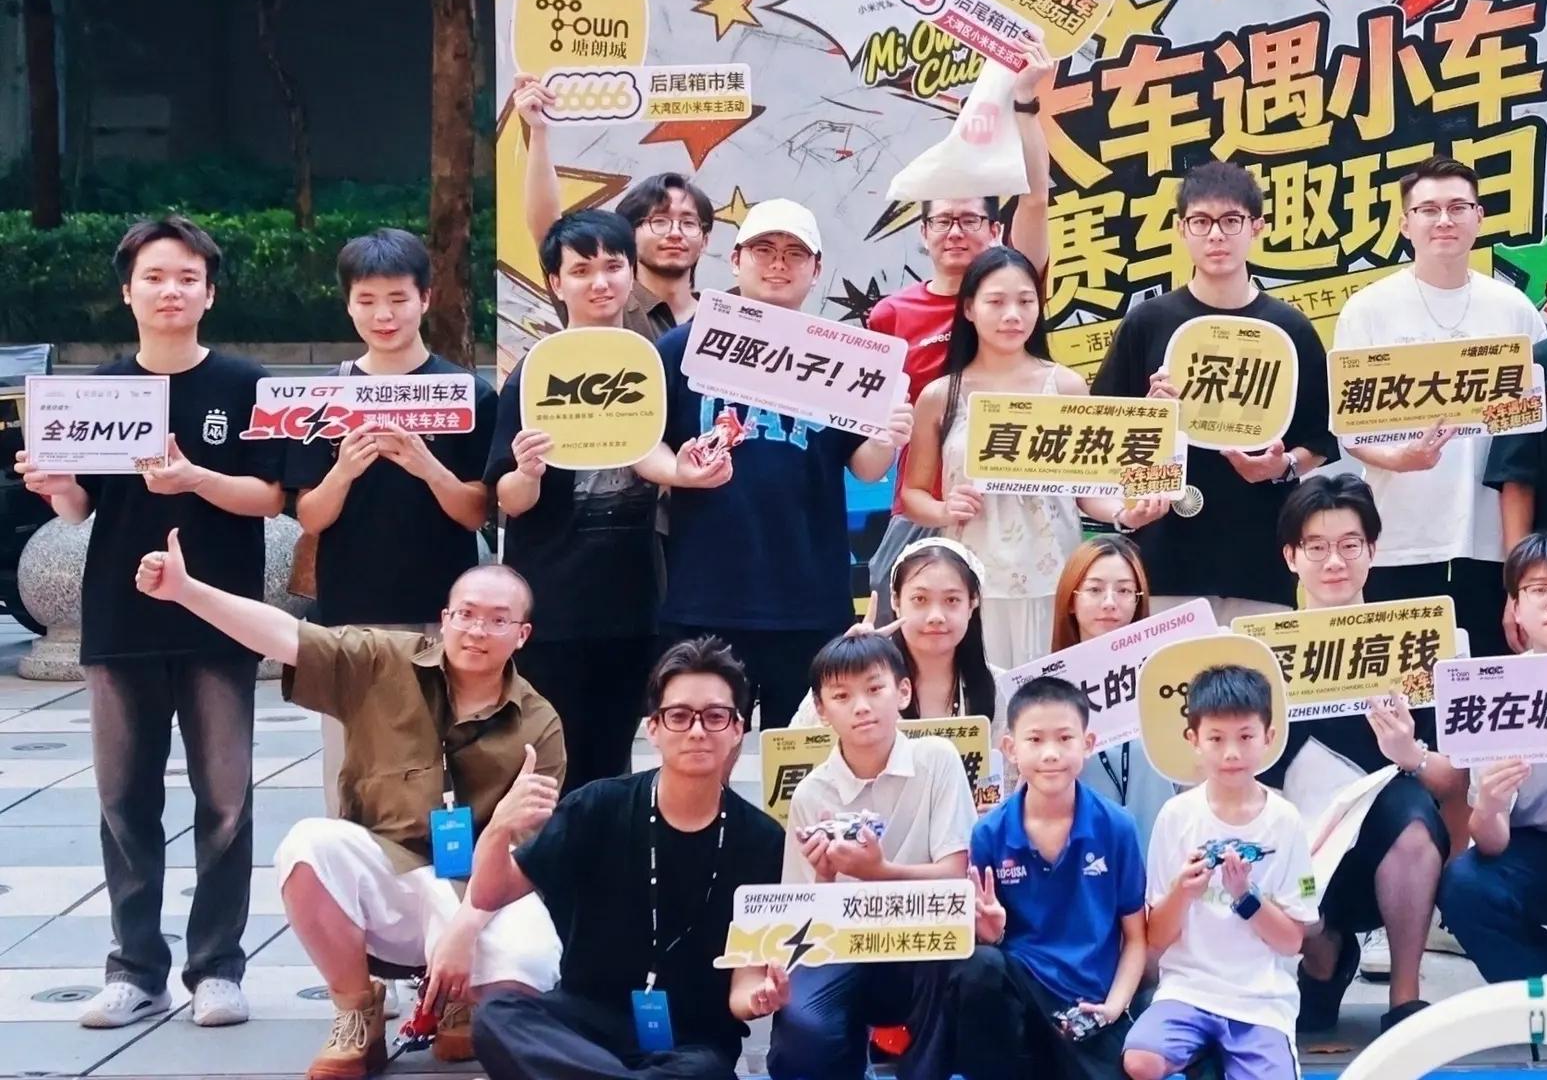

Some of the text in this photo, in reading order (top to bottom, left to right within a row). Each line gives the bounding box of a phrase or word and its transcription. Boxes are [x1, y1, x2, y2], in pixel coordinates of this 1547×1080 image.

[572, 38, 627, 59] 塘朗城
[866, 27, 907, 85] Mi
[650, 72, 745, 93] 后尾箱市集
[553, 81, 632, 112] 66666
[1038, 0, 1544, 188] 大车遇小车
[650, 100, 745, 115] 大湾区小米车主活动
[806, 325, 837, 341] GRAN
[839, 333, 890, 355] TURISMO
[1461, 342, 1520, 357] #塘朗城广场
[1179, 352, 1281, 409] 深圳
[1337, 365, 1524, 415] 潮改大玩具
[271, 386, 344, 398] YU7 GT
[356, 384, 468, 403] 欢迎深圳车友
[1060, 405, 1169, 418] #MOC深圳小米车友会
[1482, 395, 1542, 420] 大车遇小车
[41, 419, 153, 442] 全场MVP
[362, 412, 460, 430] 深圳小米车友会
[828, 414, 888, 435] YU7 GT
[1188, 420, 1263, 436] 大湾区小米车友会
[979, 423, 1163, 466] 真诚热爱
[1355, 431, 1406, 445] SHENZHEN
[1408, 431, 1424, 441] MO
[1458, 426, 1482, 436] Ultra
[1120, 463, 1183, 484] 大车遇小车
[986, 481, 1119, 496] SHENZHEN MOC SU7 YU7
[1330, 607, 1444, 627] #MOC深圳小米车友会
[1110, 612, 1196, 652] GRAN TURISMO
[1322, 703, 1345, 714] MOC
[744, 893, 816, 903] SHENZHEN MOC
[842, 893, 967, 918] 欢迎深圳车友
[744, 904, 788, 914] SU7 YU7
[848, 931, 958, 954] 深圳小米车友会
